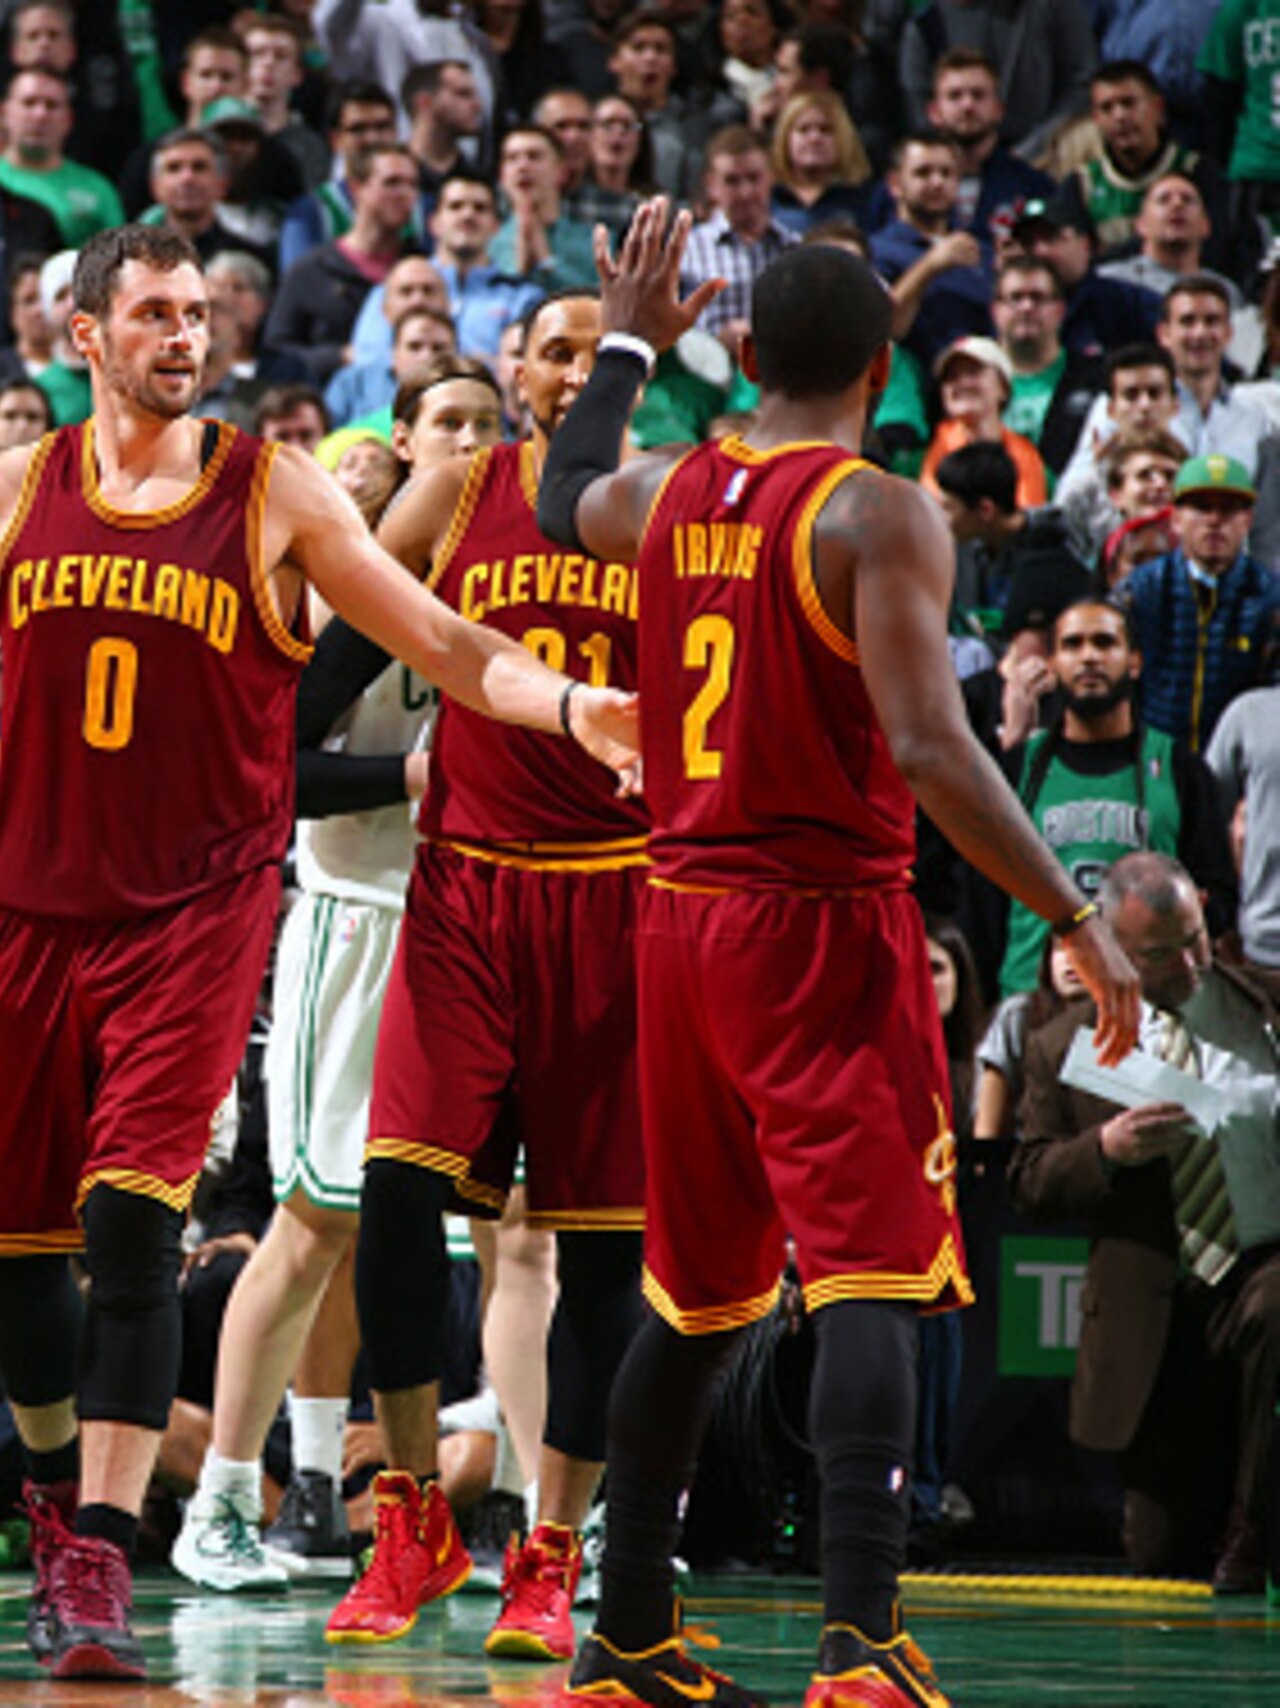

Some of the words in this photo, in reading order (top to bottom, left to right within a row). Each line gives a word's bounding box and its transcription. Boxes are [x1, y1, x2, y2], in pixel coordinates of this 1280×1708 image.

[10, 554, 240, 655] CLEVELAND
[83, 636, 138, 751] 0
[683, 613, 735, 780] 2
